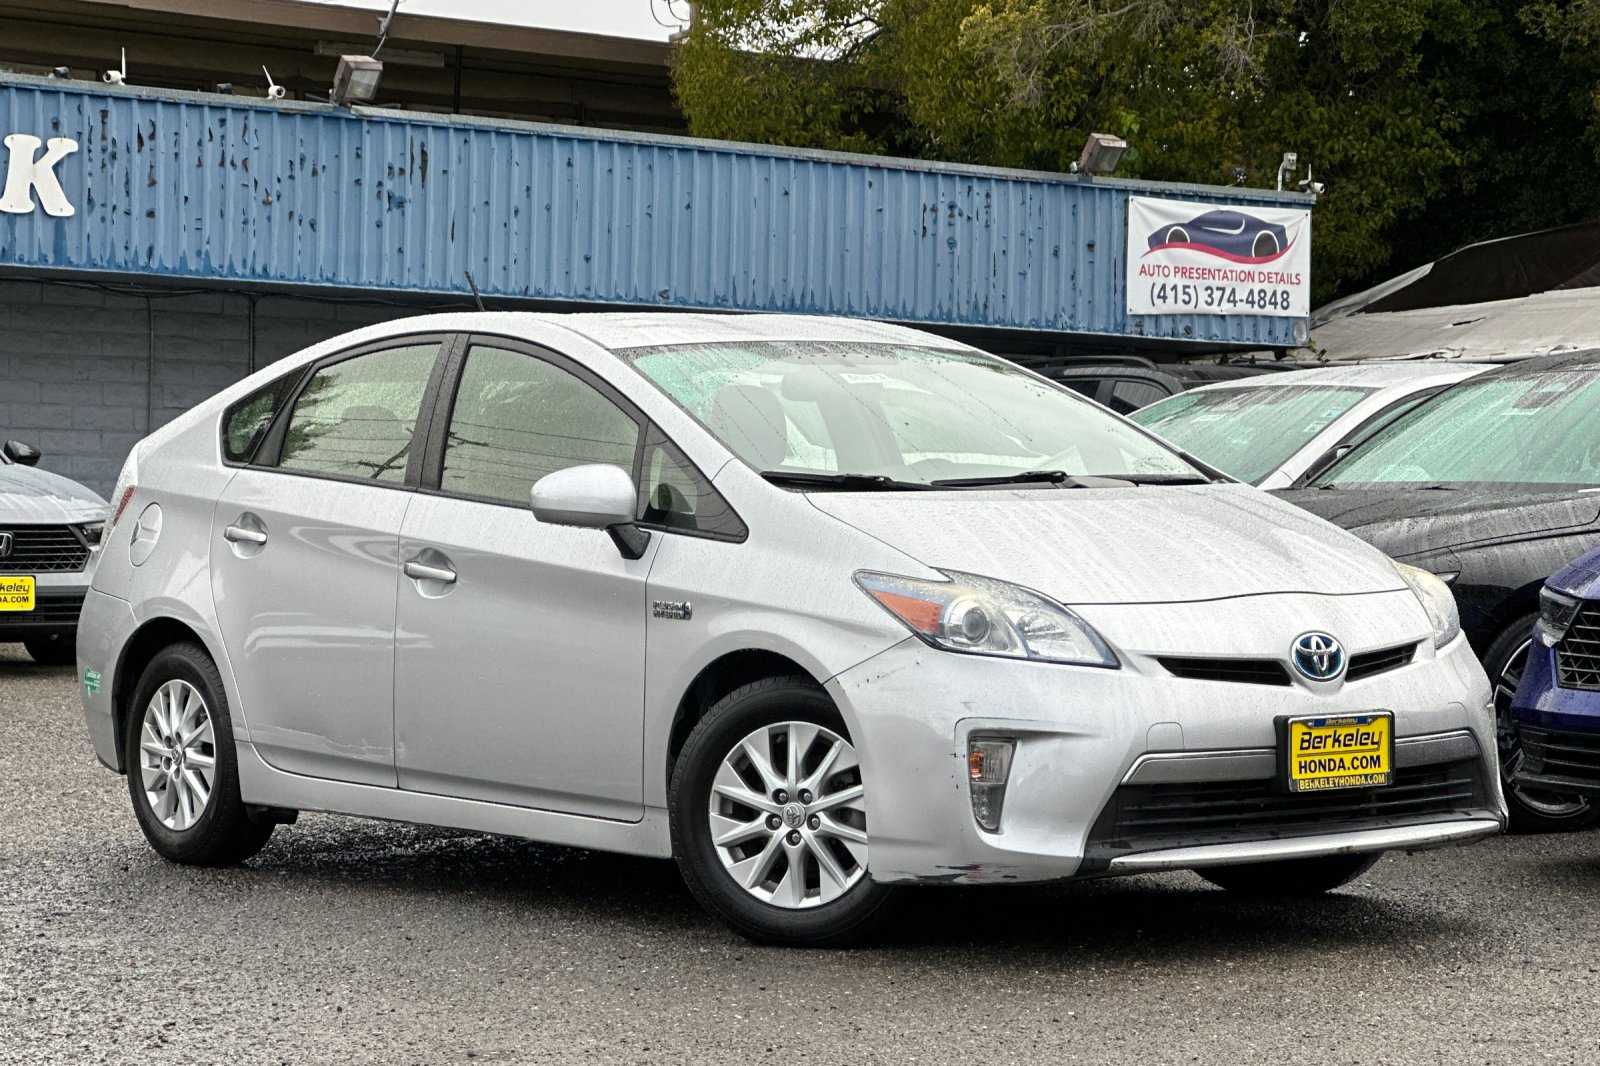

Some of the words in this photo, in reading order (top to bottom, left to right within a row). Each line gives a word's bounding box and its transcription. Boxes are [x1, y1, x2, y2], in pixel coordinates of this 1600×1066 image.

[0, 133, 79, 217] K
[1138, 263, 1171, 278] AUTO
[1173, 266, 1257, 283] PRESENTATION
[1258, 271, 1301, 286] DETAILS
[1150, 282, 1199, 309] (415)
[1204, 286, 1290, 311] 374-4848
[1300, 728, 1383, 751] Berkeley
[1298, 755, 1381, 774] HONDA.COM
[1299, 773, 1386, 790] BERKELEYHONDA.COM
